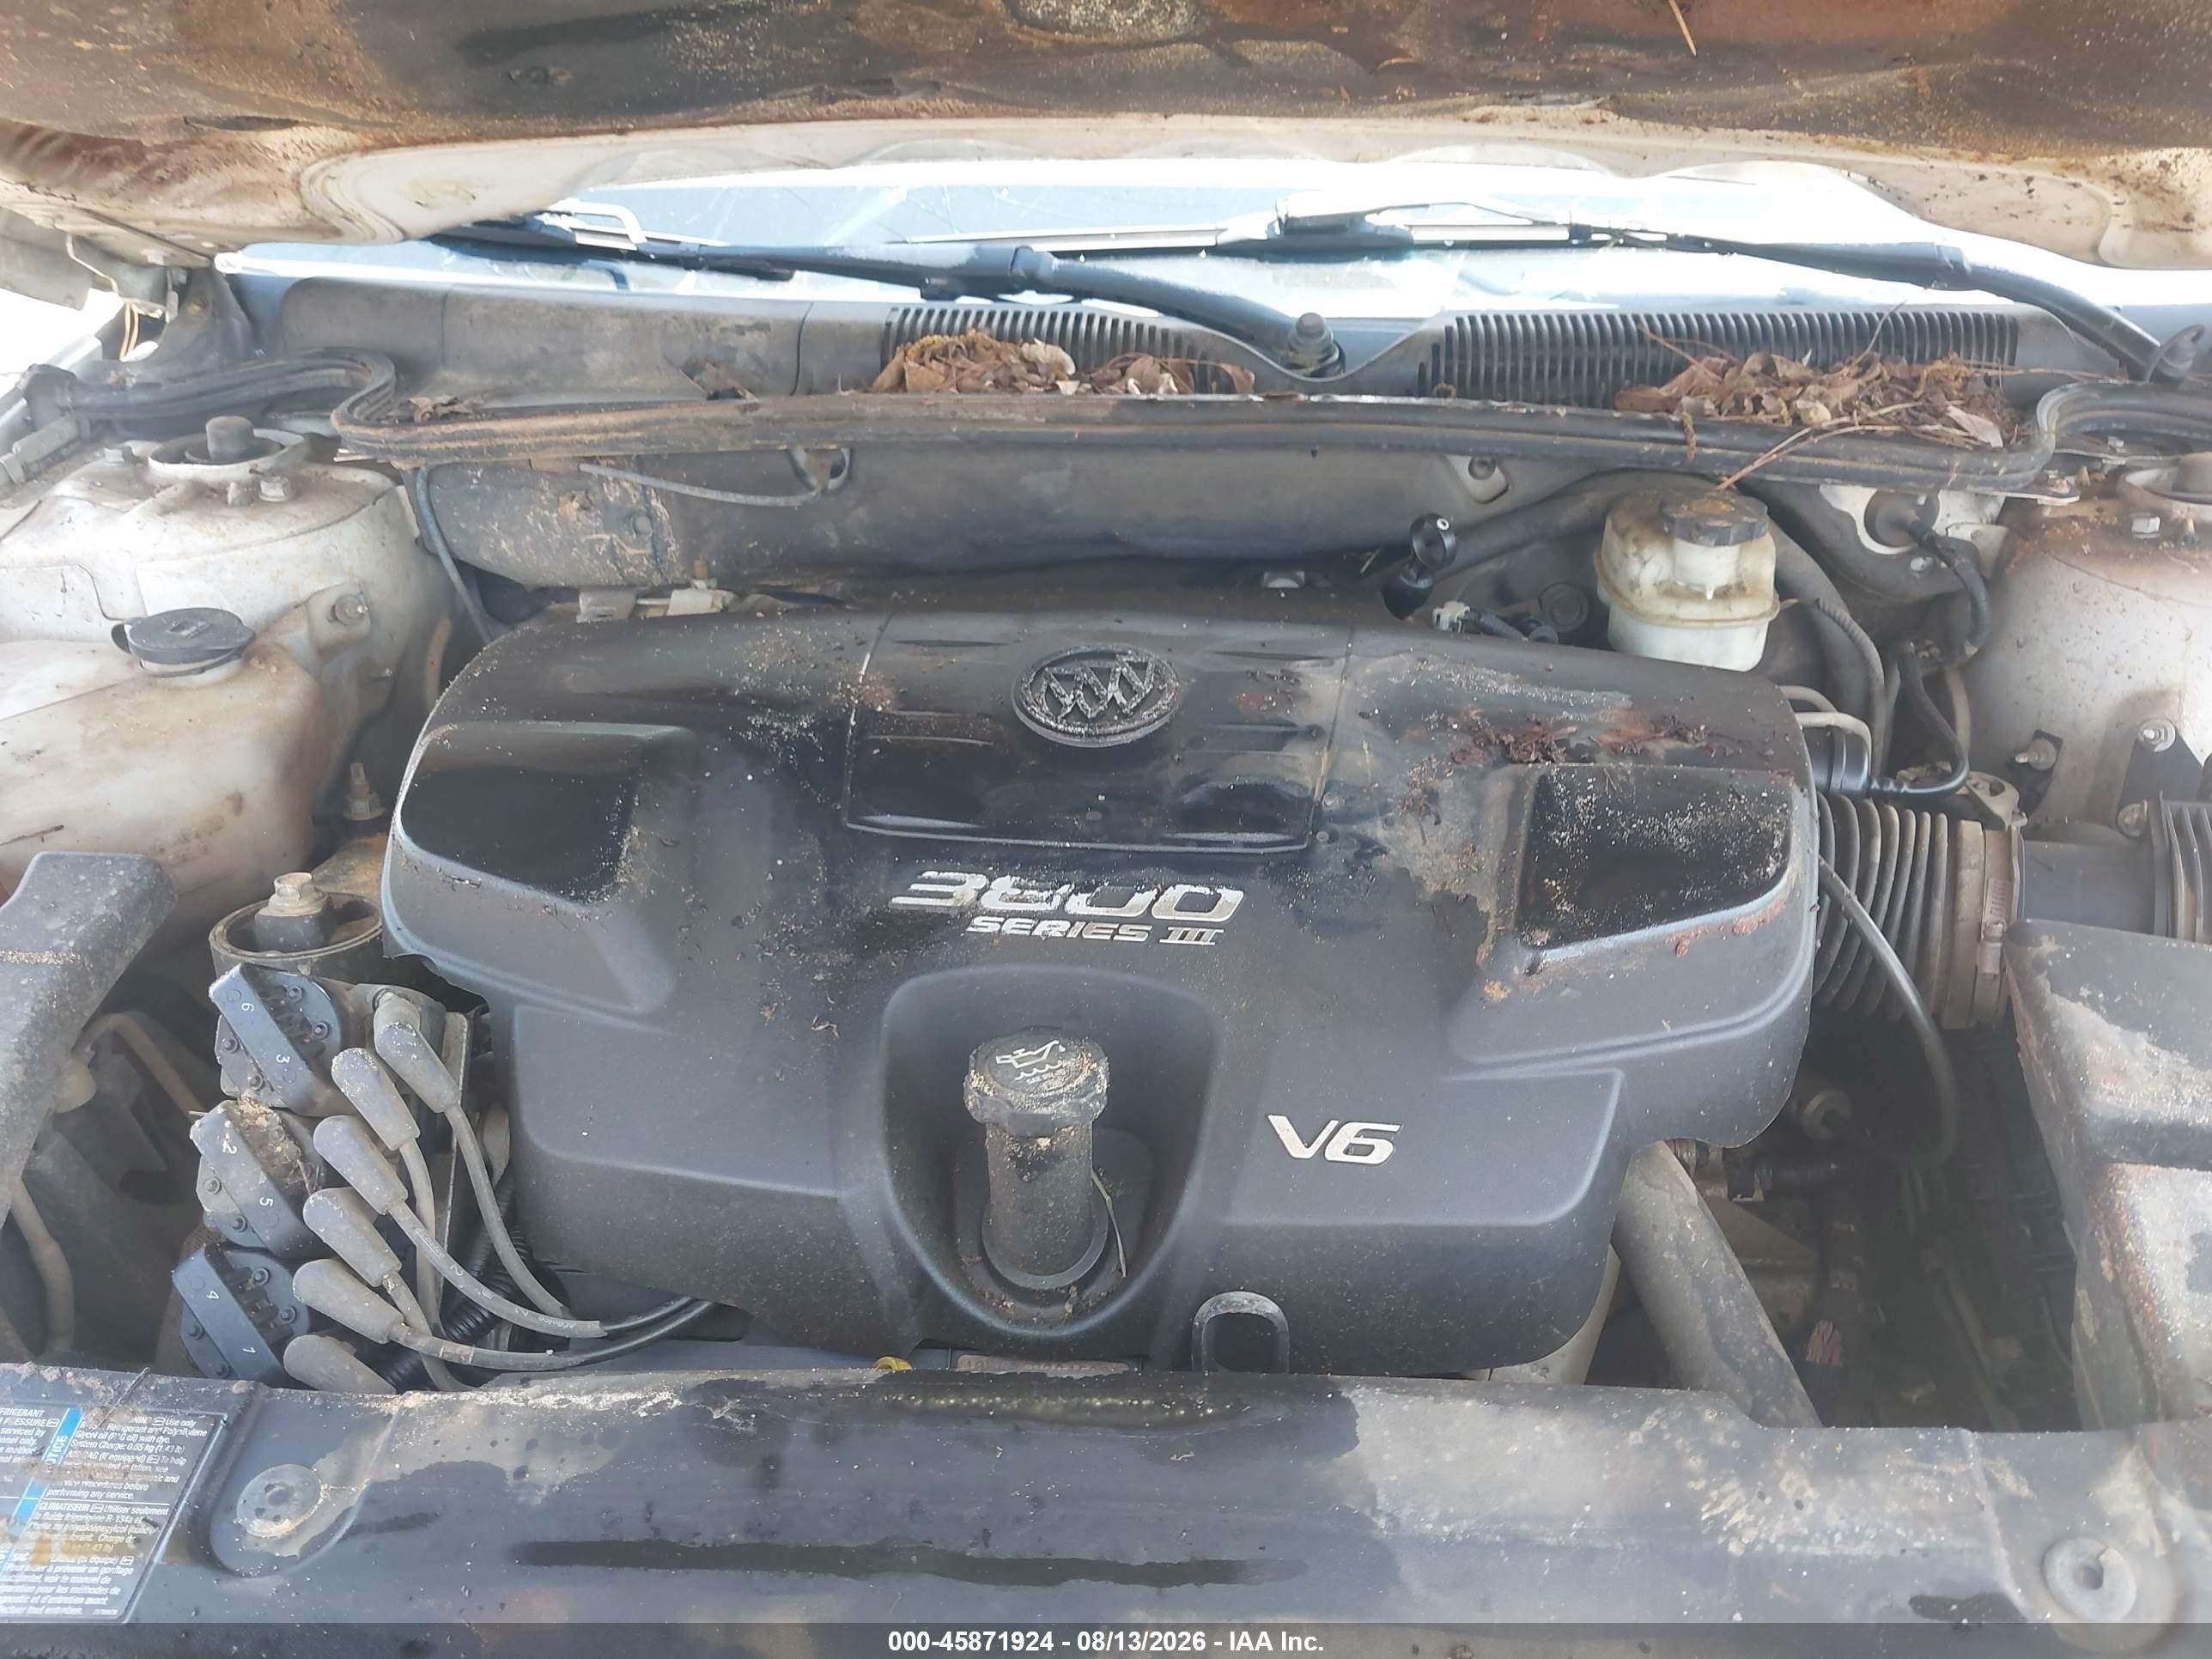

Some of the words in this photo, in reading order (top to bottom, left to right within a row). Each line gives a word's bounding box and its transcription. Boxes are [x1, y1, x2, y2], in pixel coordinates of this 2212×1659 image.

[965, 916, 1152, 942] SERIES
[1158, 927, 1224, 945] III
[241, 1002, 254, 1012] 6
[276, 1054, 290, 1063] 3
[1267, 1115, 1401, 1164] V6
[222, 1139, 237, 1154] 2
[259, 1196, 273, 1207] 5
[206, 1290, 220, 1299] 4
[165, 1418, 180, 1426] Use
[180, 1419, 198, 1429] only
[35, 1428, 46, 1437] by
[70, 1438, 98, 1449] System
[144, 1444, 155, 1453] kg
[124, 1483, 149, 1492] before
[89, 1491, 105, 1499] any
